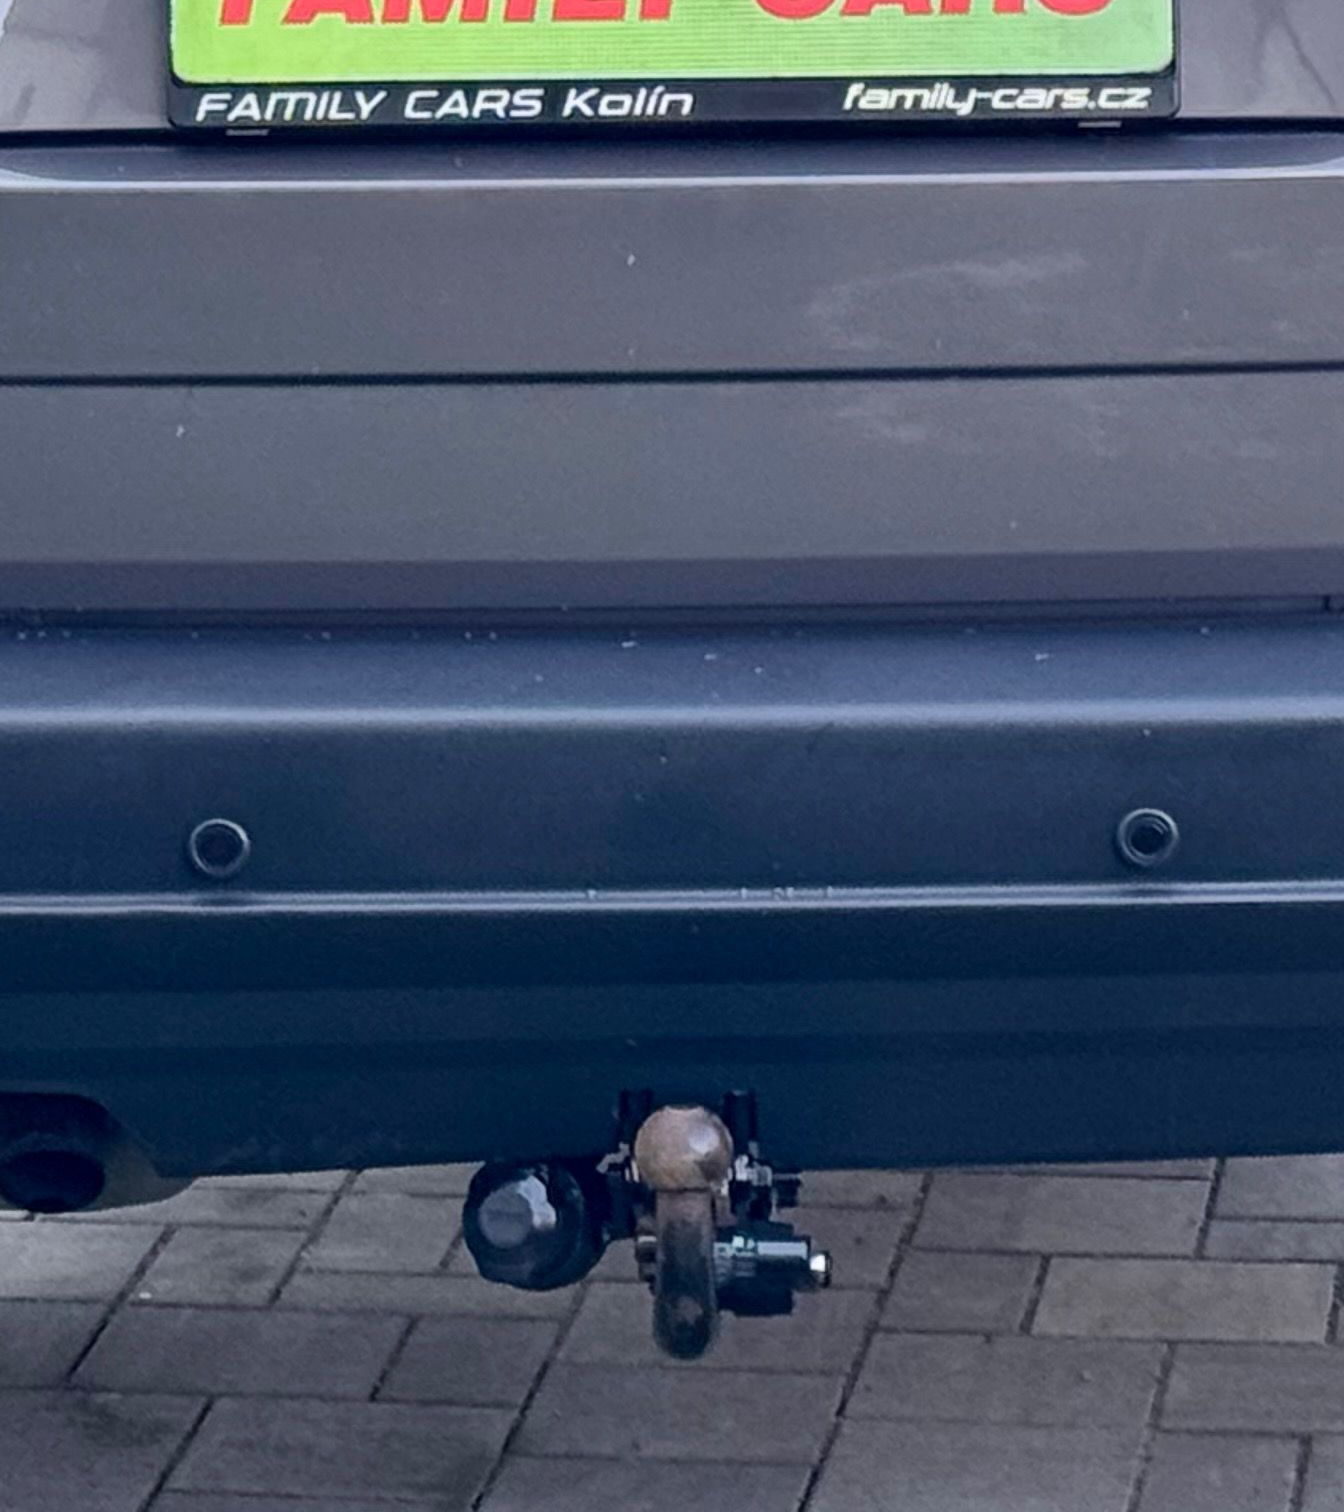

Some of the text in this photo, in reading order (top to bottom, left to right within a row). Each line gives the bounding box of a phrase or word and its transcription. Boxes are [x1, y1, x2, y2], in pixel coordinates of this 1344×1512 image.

[195, 85, 694, 122] FAMILY CARS Kolín
[842, 82, 1152, 115] family-cars.cz
